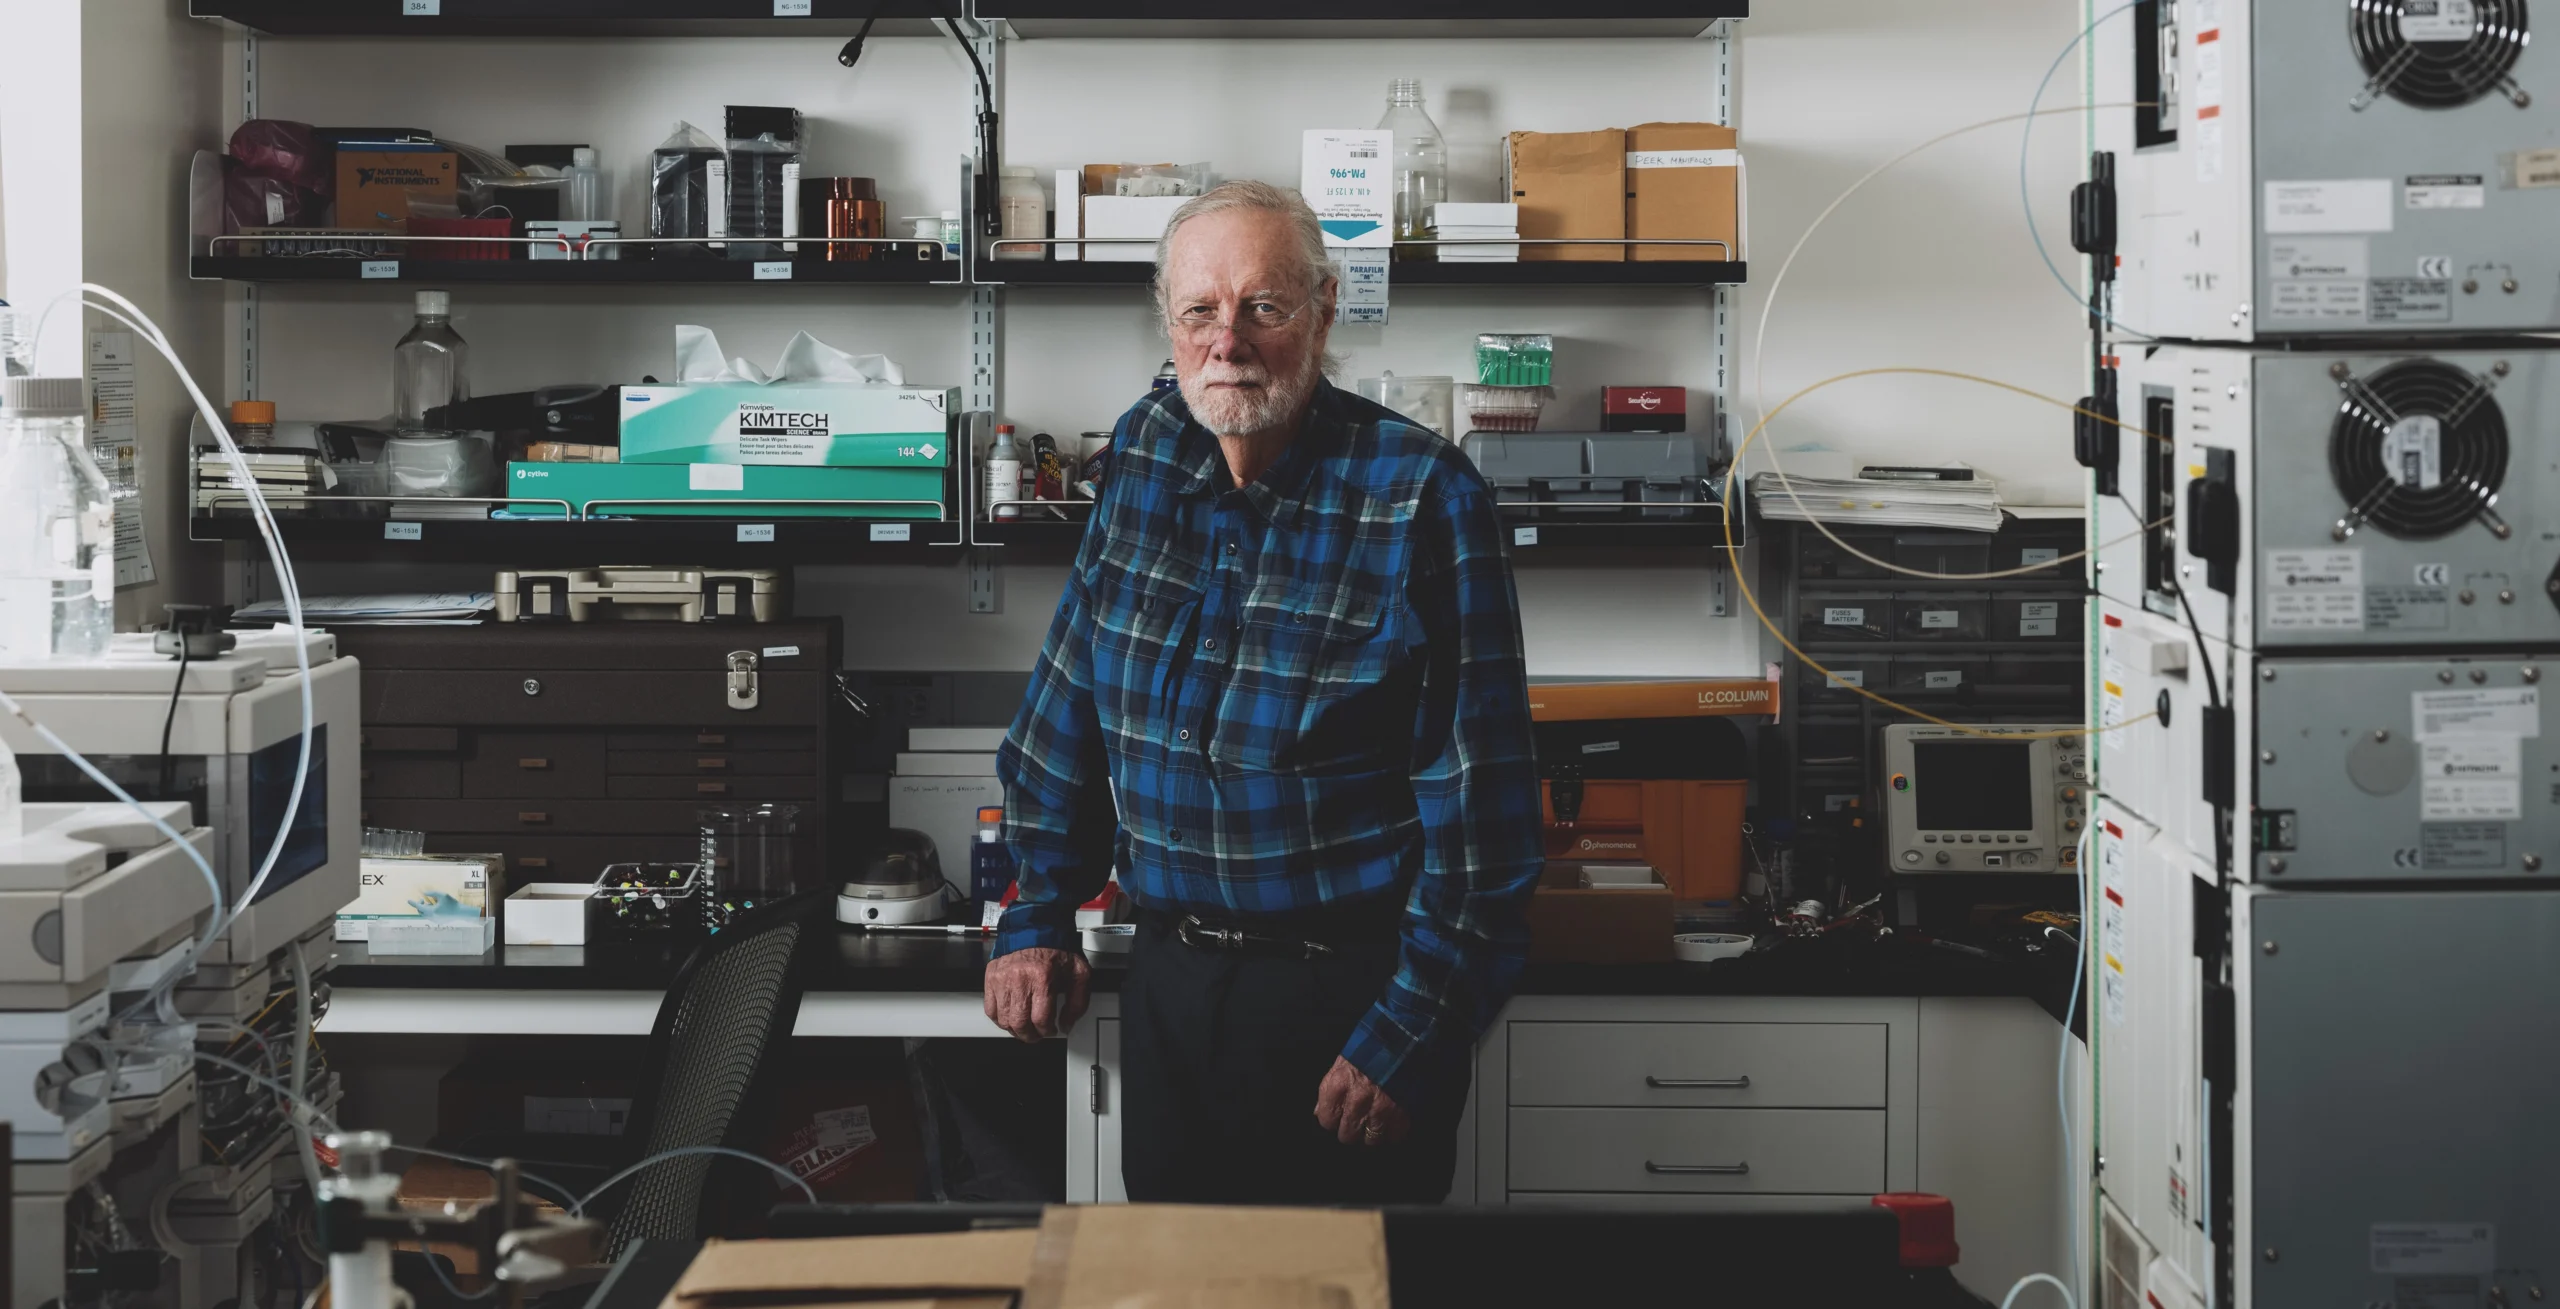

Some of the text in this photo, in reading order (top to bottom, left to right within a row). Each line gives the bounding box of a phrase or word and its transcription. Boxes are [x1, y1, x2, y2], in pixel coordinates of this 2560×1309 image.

[1635, 155, 1713, 166] PEEK MANIFOLDS
[377, 168, 424, 176] NATIONAL
[1330, 168, 1366, 178] PM-996
[375, 177, 440, 185] INSTRUMENTS
[937, 394, 943, 408] 1
[1628, 397, 1661, 405] SecurityGuard
[740, 412, 829, 428] KIMTECH
[897, 446, 915, 457] 144
[527, 470, 548, 478] cytiva
[1698, 689, 1769, 703] LC COLUMN
[1592, 841, 1637, 850] phenomenex
[471, 870, 480, 878] XL
[361, 875, 384, 885] EX
